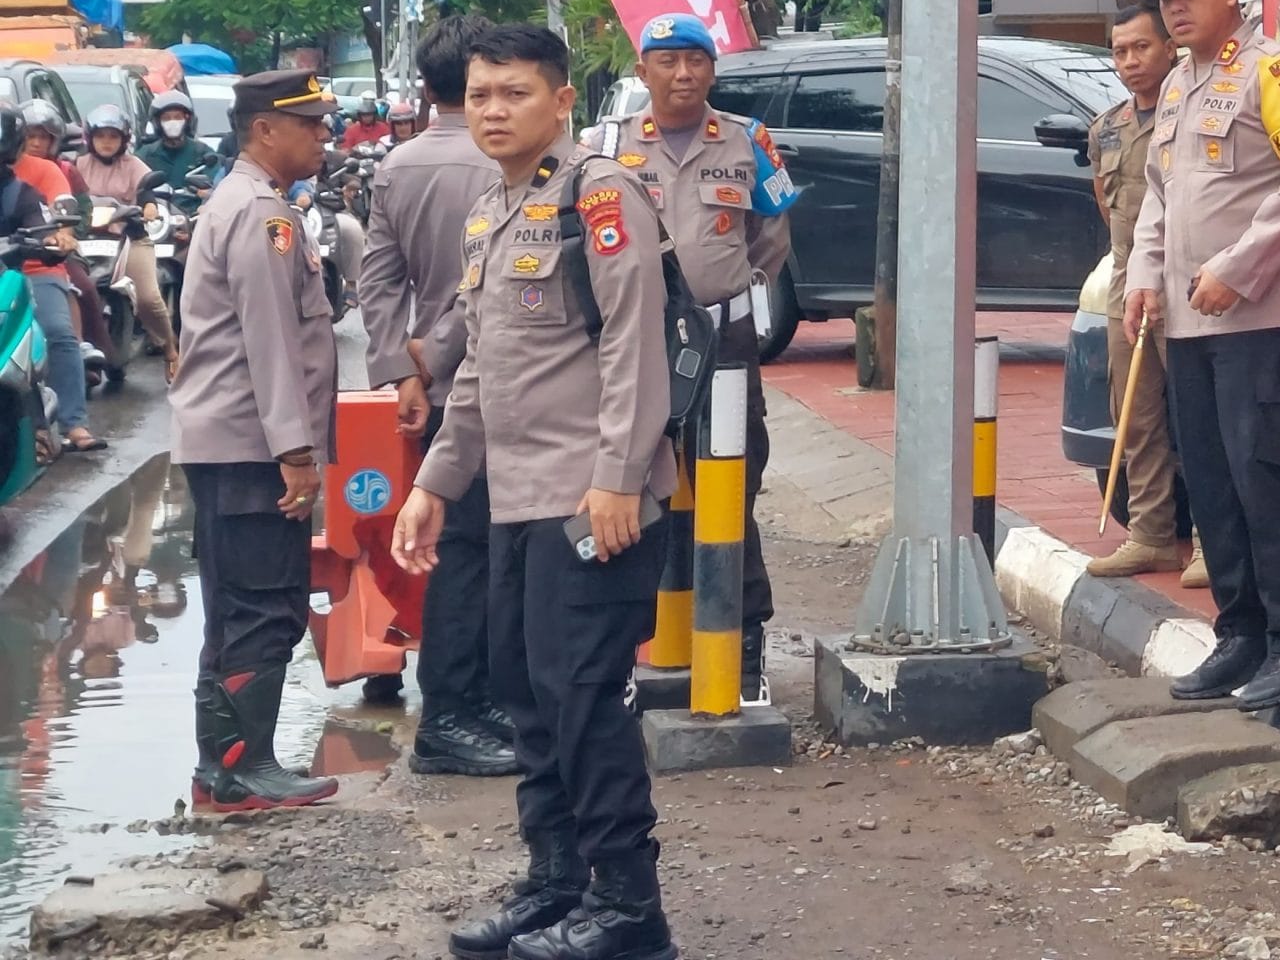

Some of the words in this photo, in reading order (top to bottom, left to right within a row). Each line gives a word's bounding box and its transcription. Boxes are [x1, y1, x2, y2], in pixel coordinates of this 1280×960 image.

[1202, 98, 1237, 111] POLRI
[701, 168, 747, 181] POLRI
[514, 230, 560, 243] POLRI
